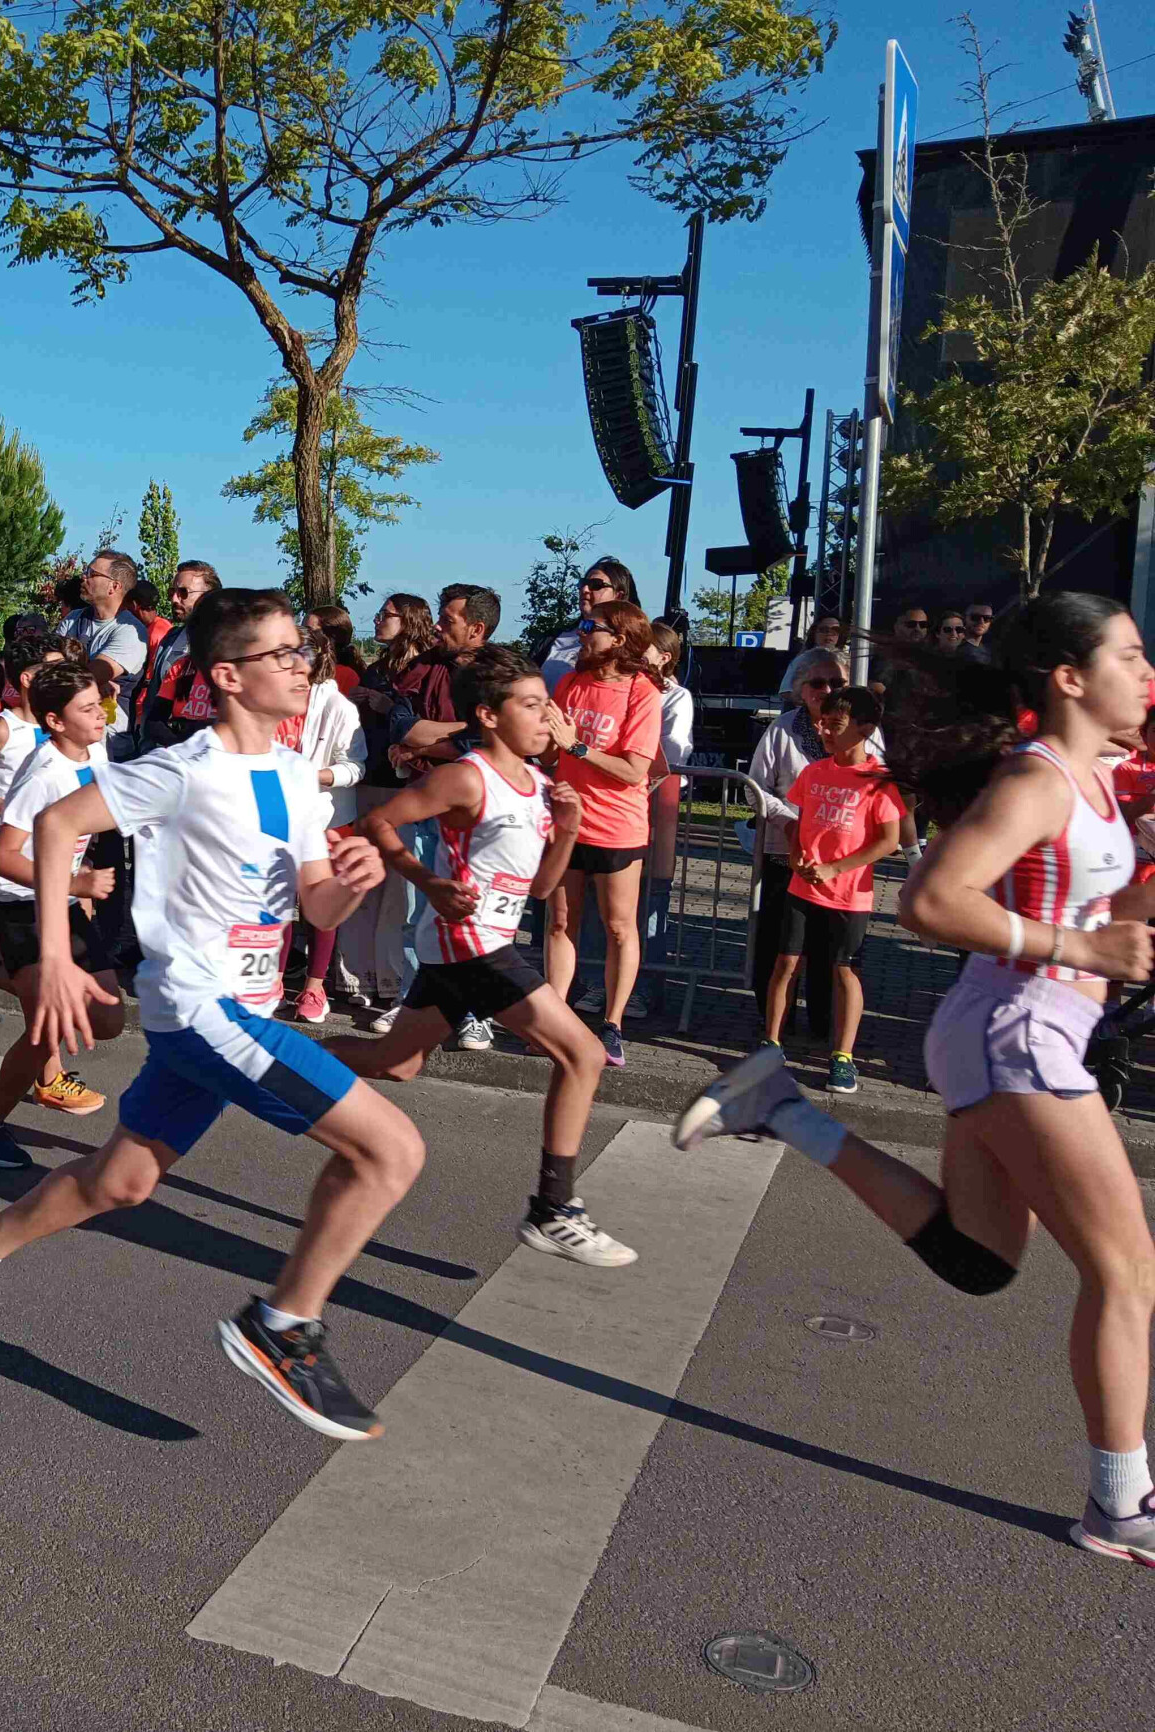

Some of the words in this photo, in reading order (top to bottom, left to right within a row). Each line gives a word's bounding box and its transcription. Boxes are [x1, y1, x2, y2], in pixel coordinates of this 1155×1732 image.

[582, 731, 609, 749] DE
[814, 803, 856, 826] ADE
[240, 952, 276, 977] 20
